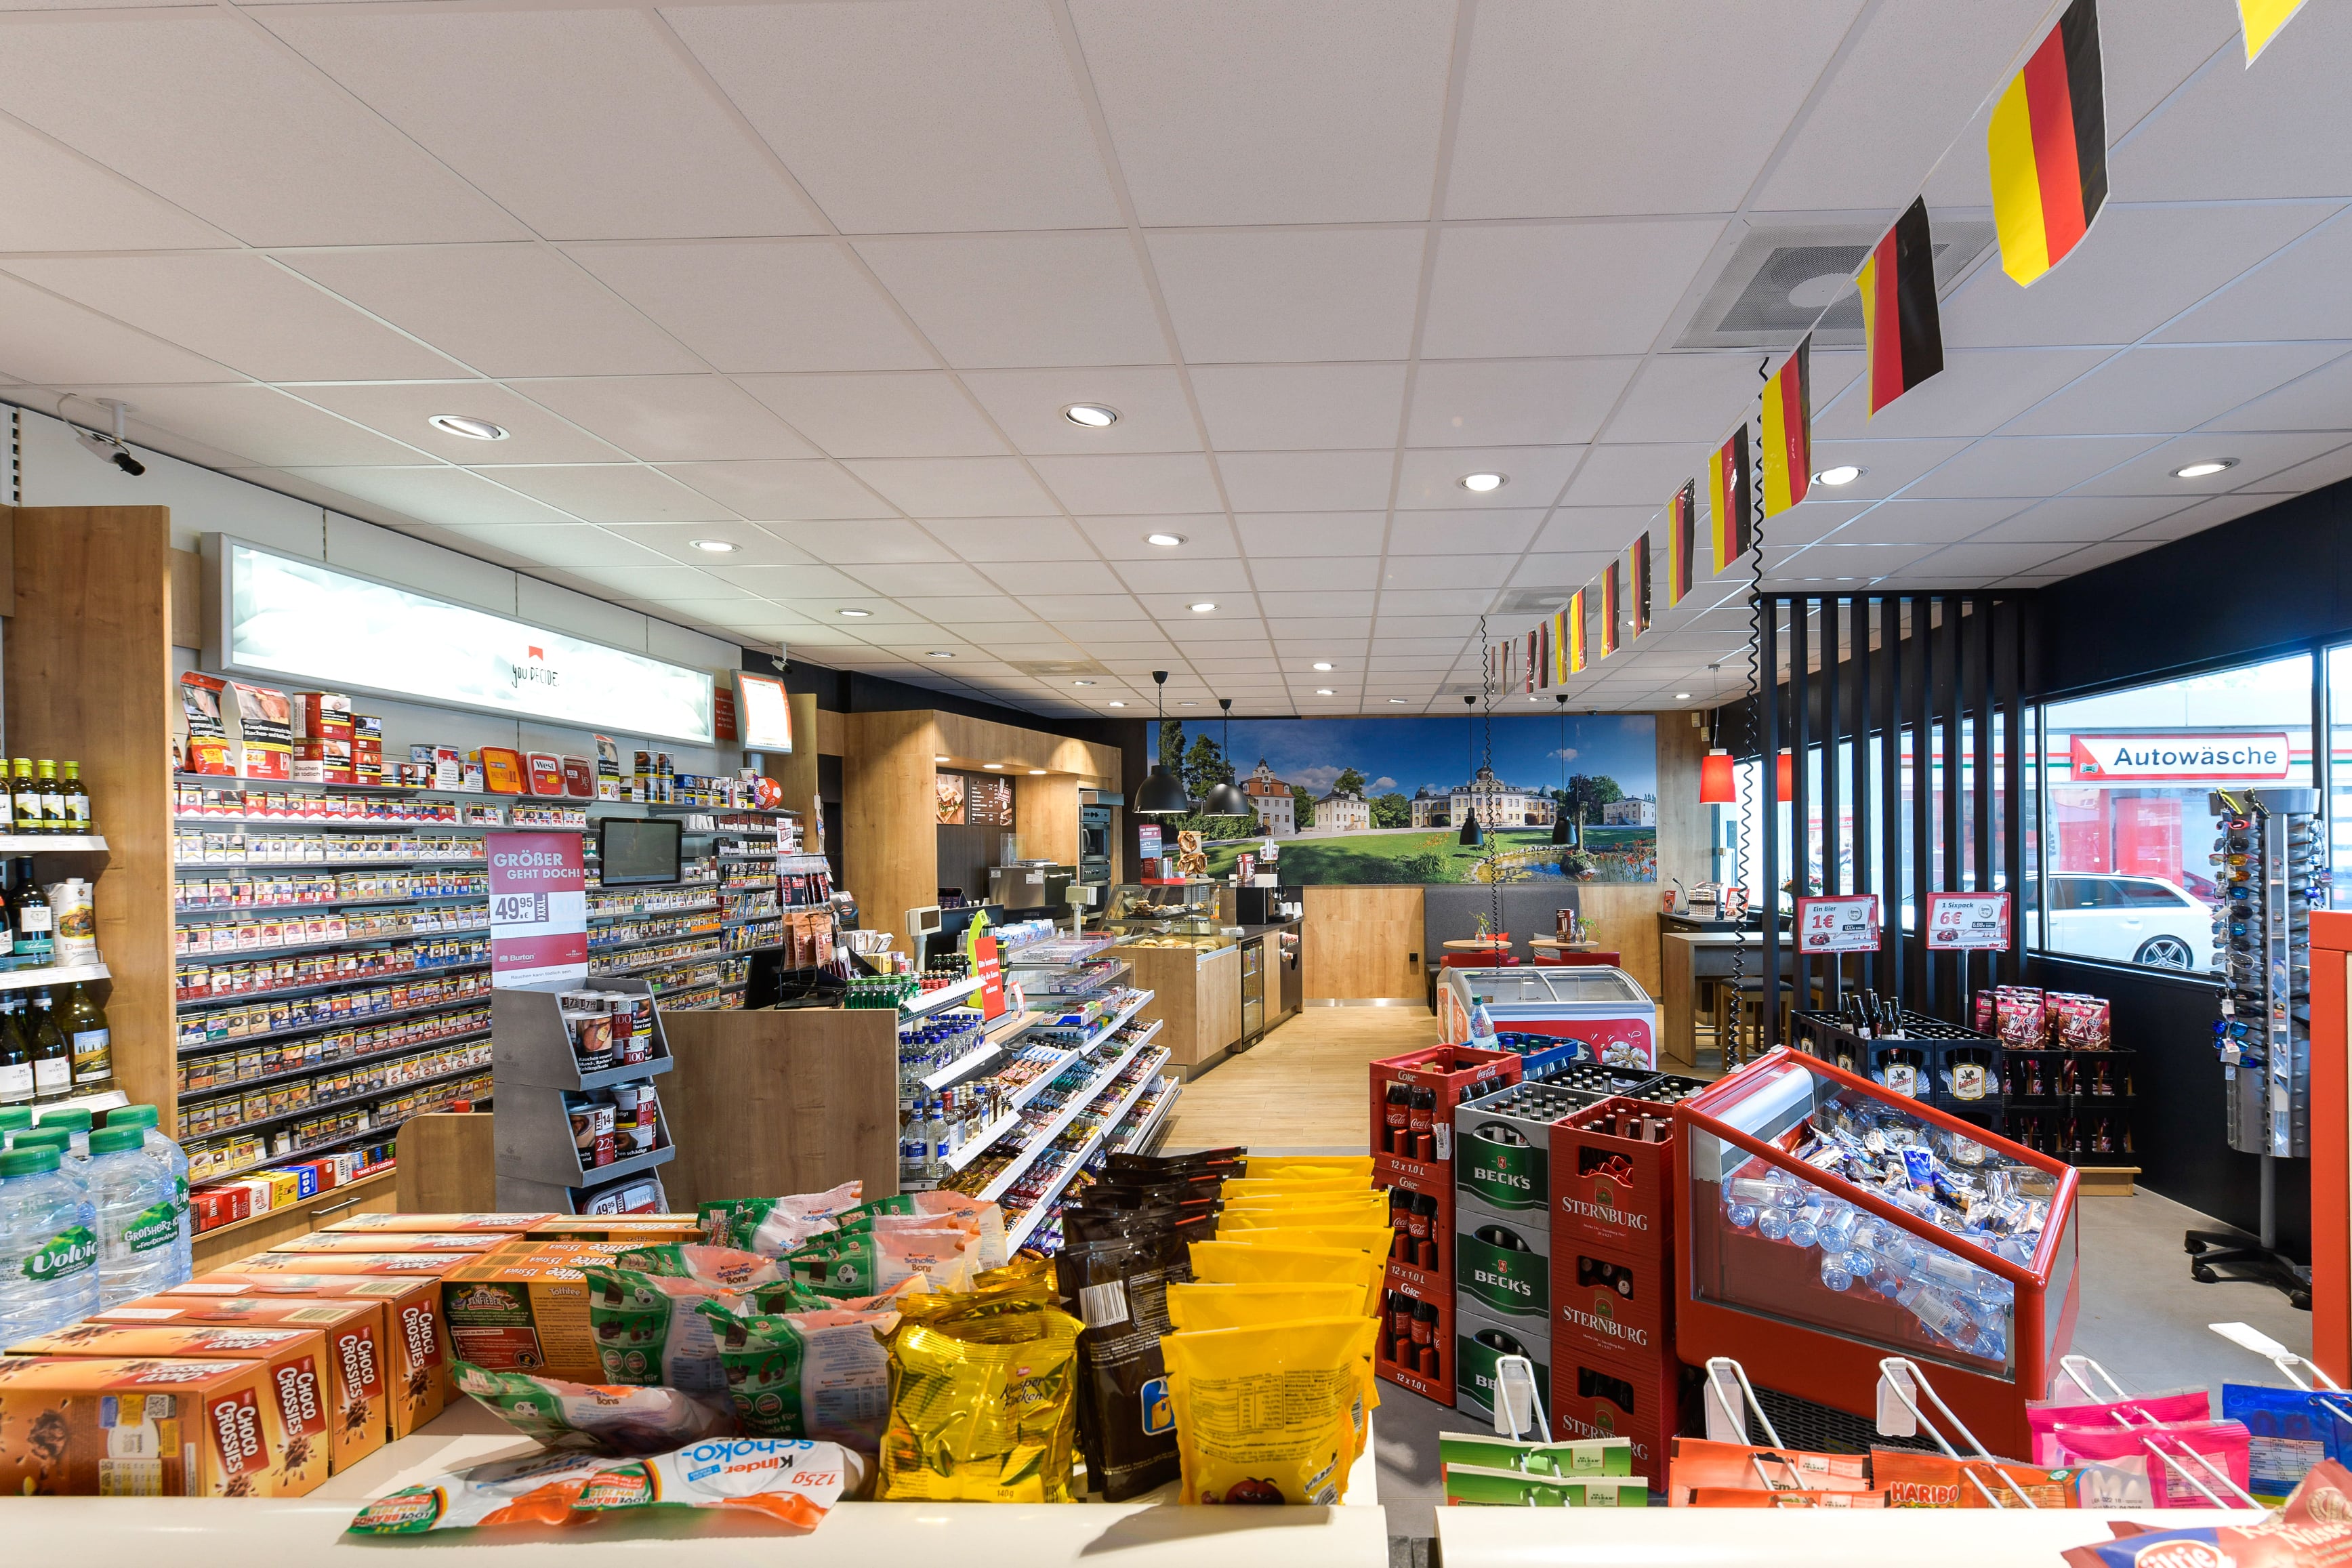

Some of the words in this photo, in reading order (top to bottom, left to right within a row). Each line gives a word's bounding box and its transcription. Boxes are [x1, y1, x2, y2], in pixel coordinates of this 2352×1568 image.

[2113, 746, 2277, 766] Autowäsche
[535, 761, 554, 770] West
[507, 869, 538, 880] GEHT
[542, 868, 580, 879] DOCH!
[1812, 914, 1834, 928] 1€
[1940, 911, 1962, 925] 6€
[615, 1014, 632, 1025] 100
[2001, 1028, 2021, 1036] COLA
[2063, 1028, 2084, 1037] COLA
[629, 1051, 644, 1062] 100
[1398, 1070, 1416, 1082] Coke
[640, 1102, 654, 1112] 100
[1390, 1159, 1399, 1168] 12
[1408, 1163, 1418, 1174] 1.0
[302, 1171, 310, 1194] OCB
[1399, 1177, 1418, 1190] Coke
[1474, 1167, 1531, 1189] BECK'S
[1562, 1197, 1647, 1231] STERNBURG
[33, 1241, 98, 1273] Volvic
[716, 1266, 755, 1279] Schoko-
[911, 1264, 932, 1273] Bons
[1391, 1265, 1400, 1275] 12
[1408, 1270, 1419, 1282] 1.0
[1420, 1275, 1425, 1283] L
[726, 1275, 749, 1284] Bons
[1474, 1269, 1531, 1296] BECK'S
[549, 1287, 581, 1296] Toffifee
[1401, 1283, 1420, 1298] Coke
[1562, 1305, 1647, 1346] STERNBURG
[402, 1307, 425, 1368] CROSSIES
[418, 1312, 435, 1355] CHOCO
[338, 1334, 364, 1399] CROSSIES
[356, 1340, 375, 1385] CHOCO
[612, 1372, 643, 1383] Prämien
[644, 1374, 658, 1382] für
[1396, 1372, 1405, 1382] 12
[1411, 1377, 1422, 1389] 1.0
[1422, 1383, 1427, 1392] L
[276, 1366, 304, 1435] CROSSIES
[295, 1371, 317, 1420] CHOCO
[596, 1395, 619, 1405] Bons
[213, 1401, 245, 1474] CROSSIES
[236, 1405, 259, 1457] CHOCO
[681, 1439, 814, 1463] Schoko-
[724, 1454, 793, 1474] Kinder
[791, 1471, 836, 1487] 125g
[589, 1489, 612, 1498] 2018
[1890, 1481, 1960, 1504] HARIBO
